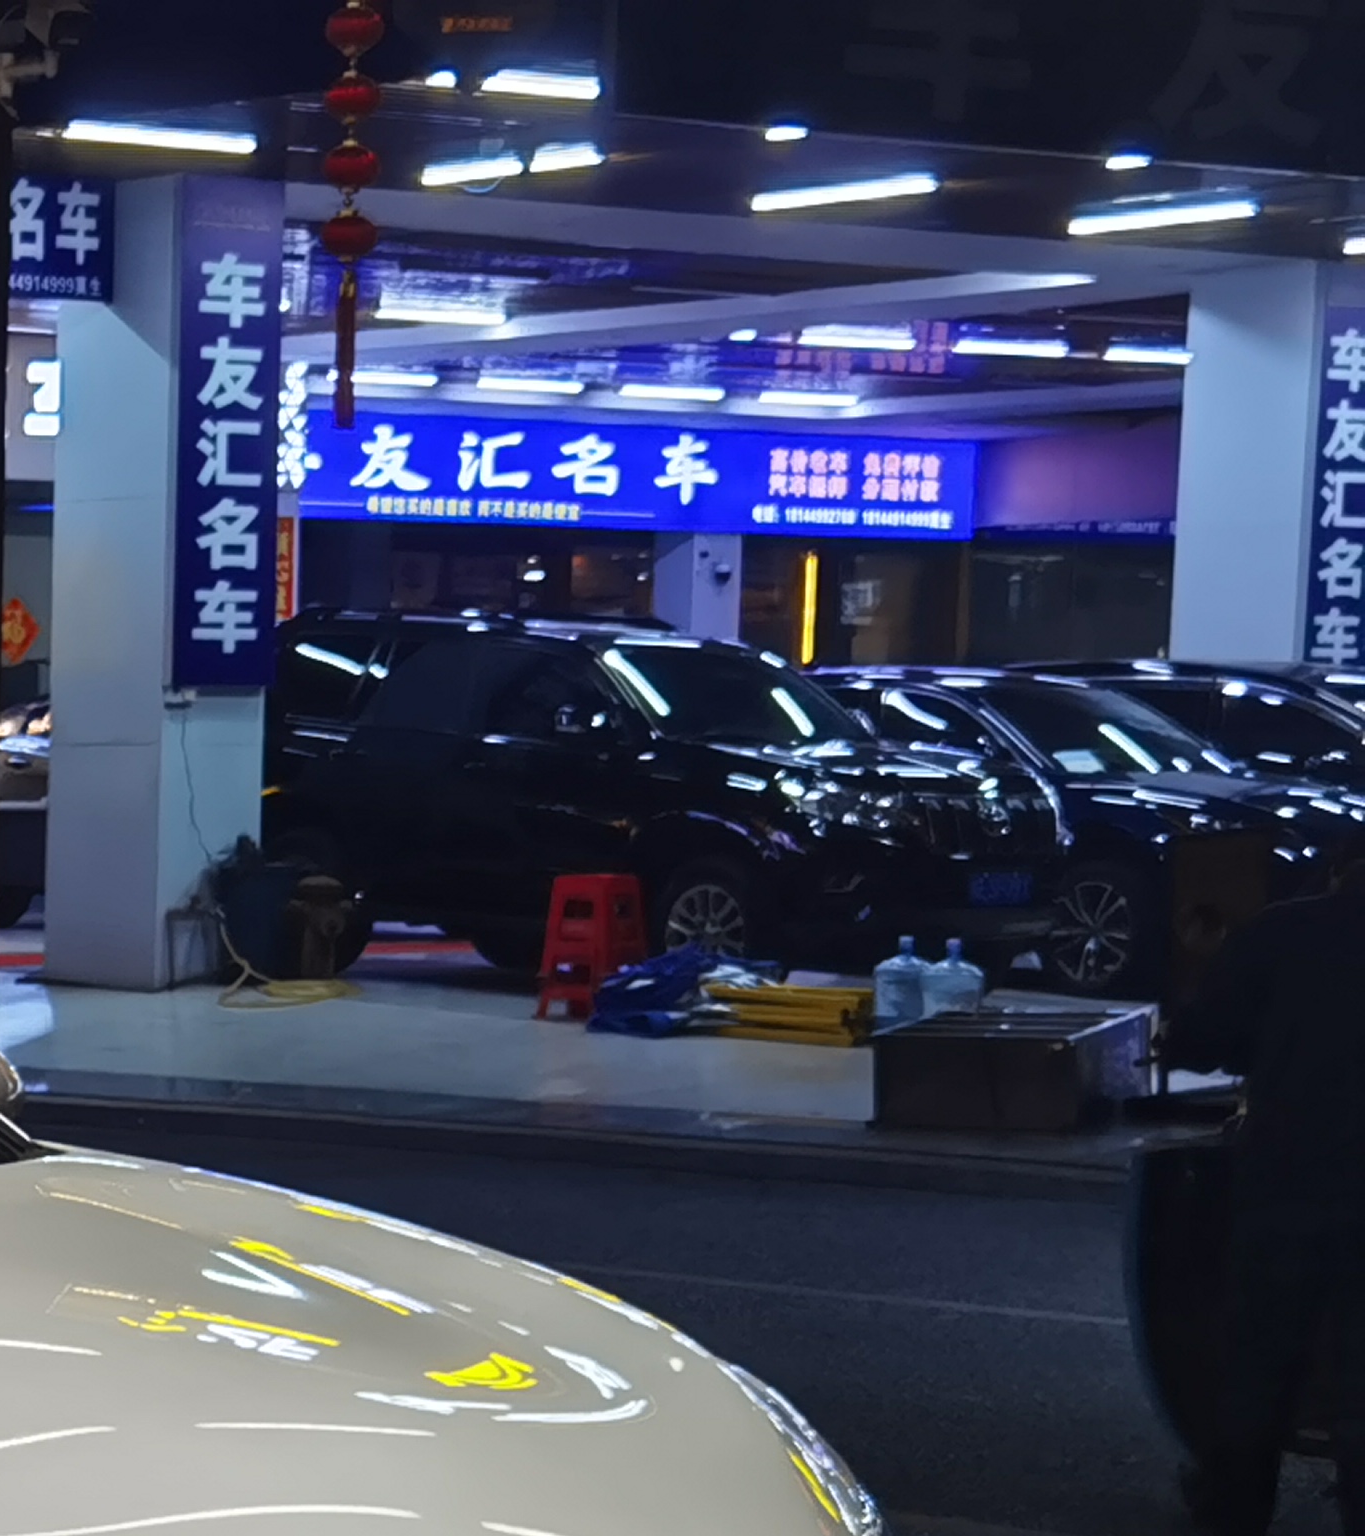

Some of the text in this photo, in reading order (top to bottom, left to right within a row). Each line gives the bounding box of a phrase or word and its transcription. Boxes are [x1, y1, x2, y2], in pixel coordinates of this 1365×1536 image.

[10, 177, 101, 266] 名车
[191, 252, 267, 655] 车友汇名车
[305, 423, 719, 506] 友汇名车
[1310, 327, 1365, 665] 车友汇名车
